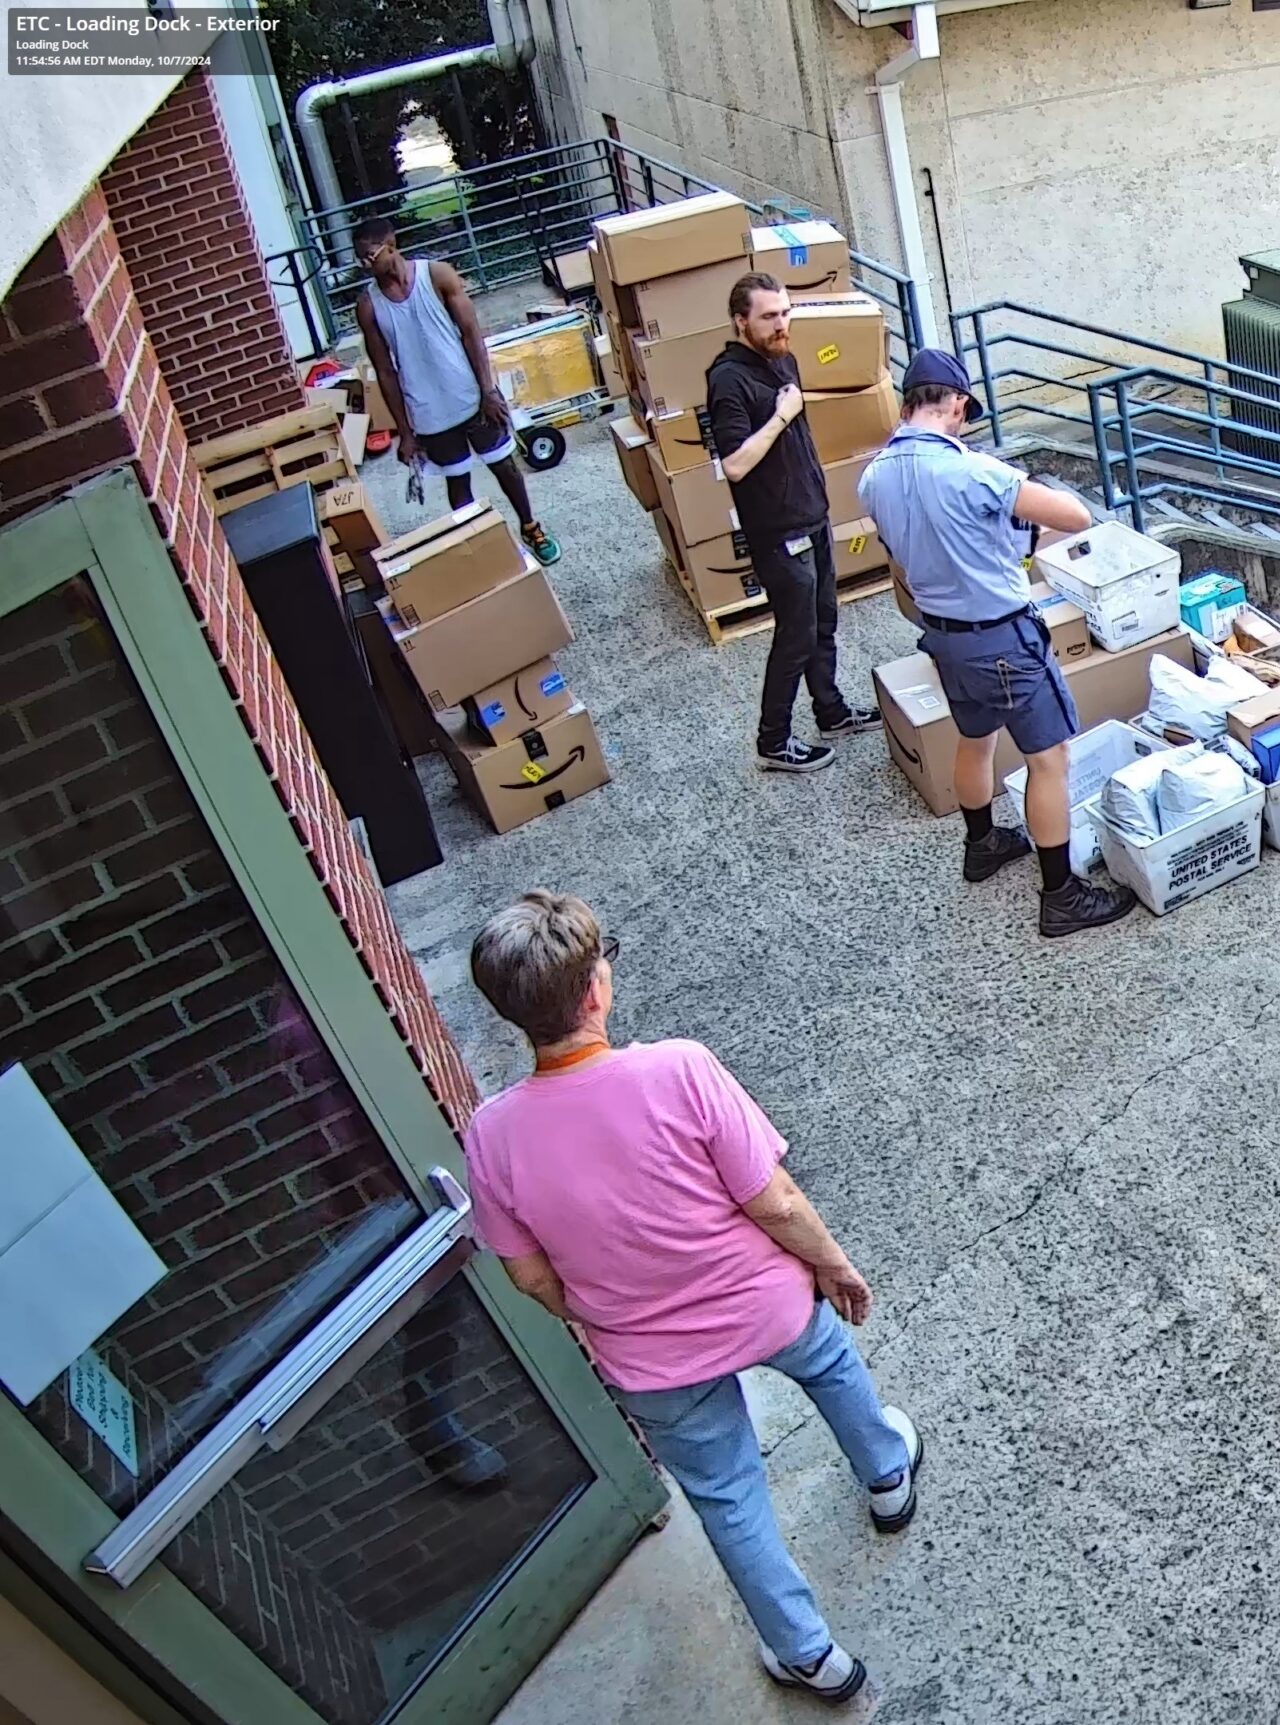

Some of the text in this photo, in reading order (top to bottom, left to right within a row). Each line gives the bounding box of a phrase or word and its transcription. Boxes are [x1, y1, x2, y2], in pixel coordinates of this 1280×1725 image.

[1168, 866, 1207, 891] POSTAL
[1210, 843, 1252, 870] SERVICE
[1171, 855, 1208, 878] UNITED
[1210, 835, 1248, 860] STATES
